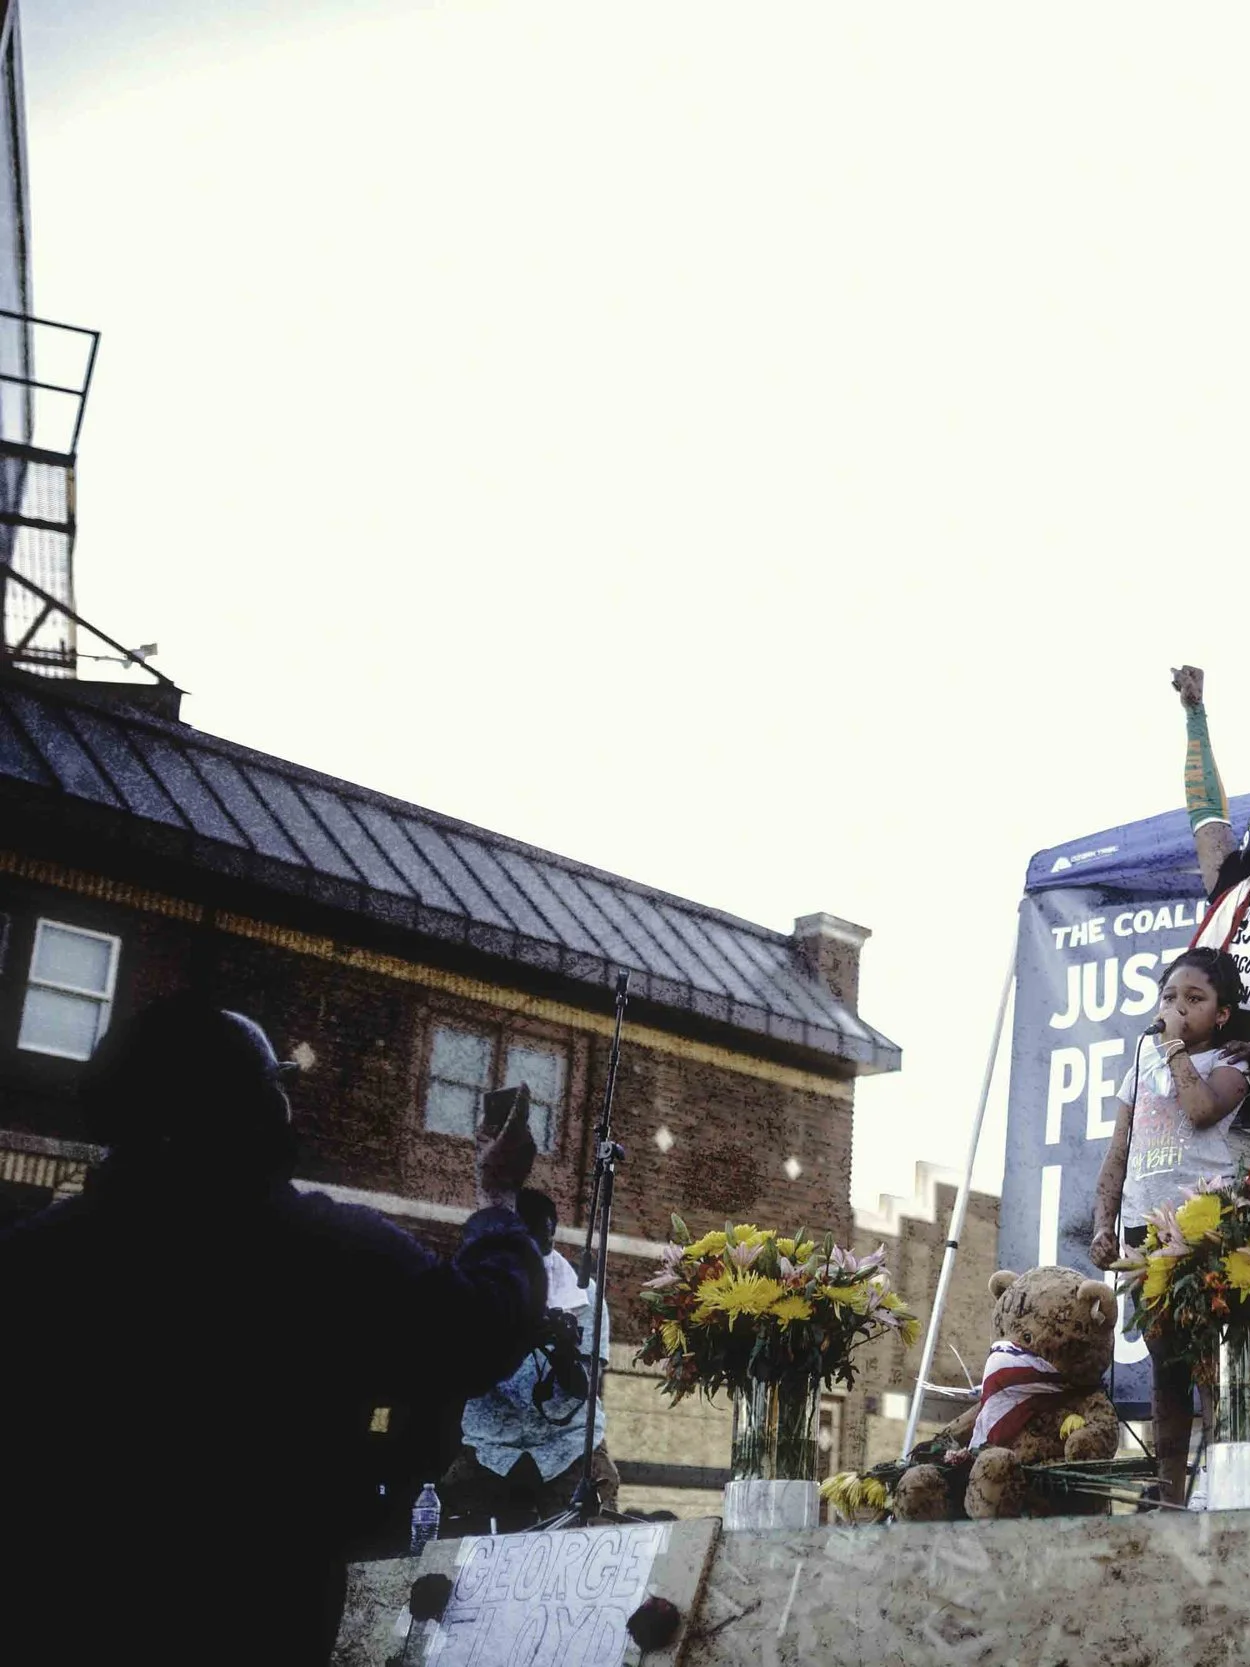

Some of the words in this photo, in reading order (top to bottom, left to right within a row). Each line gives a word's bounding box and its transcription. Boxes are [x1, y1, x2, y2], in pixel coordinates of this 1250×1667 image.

[1052, 917, 1106, 950] THE
[1113, 900, 1210, 937] COALI
[1045, 1036, 1153, 1145] PE
[454, 1529, 659, 1603] GEORGE
